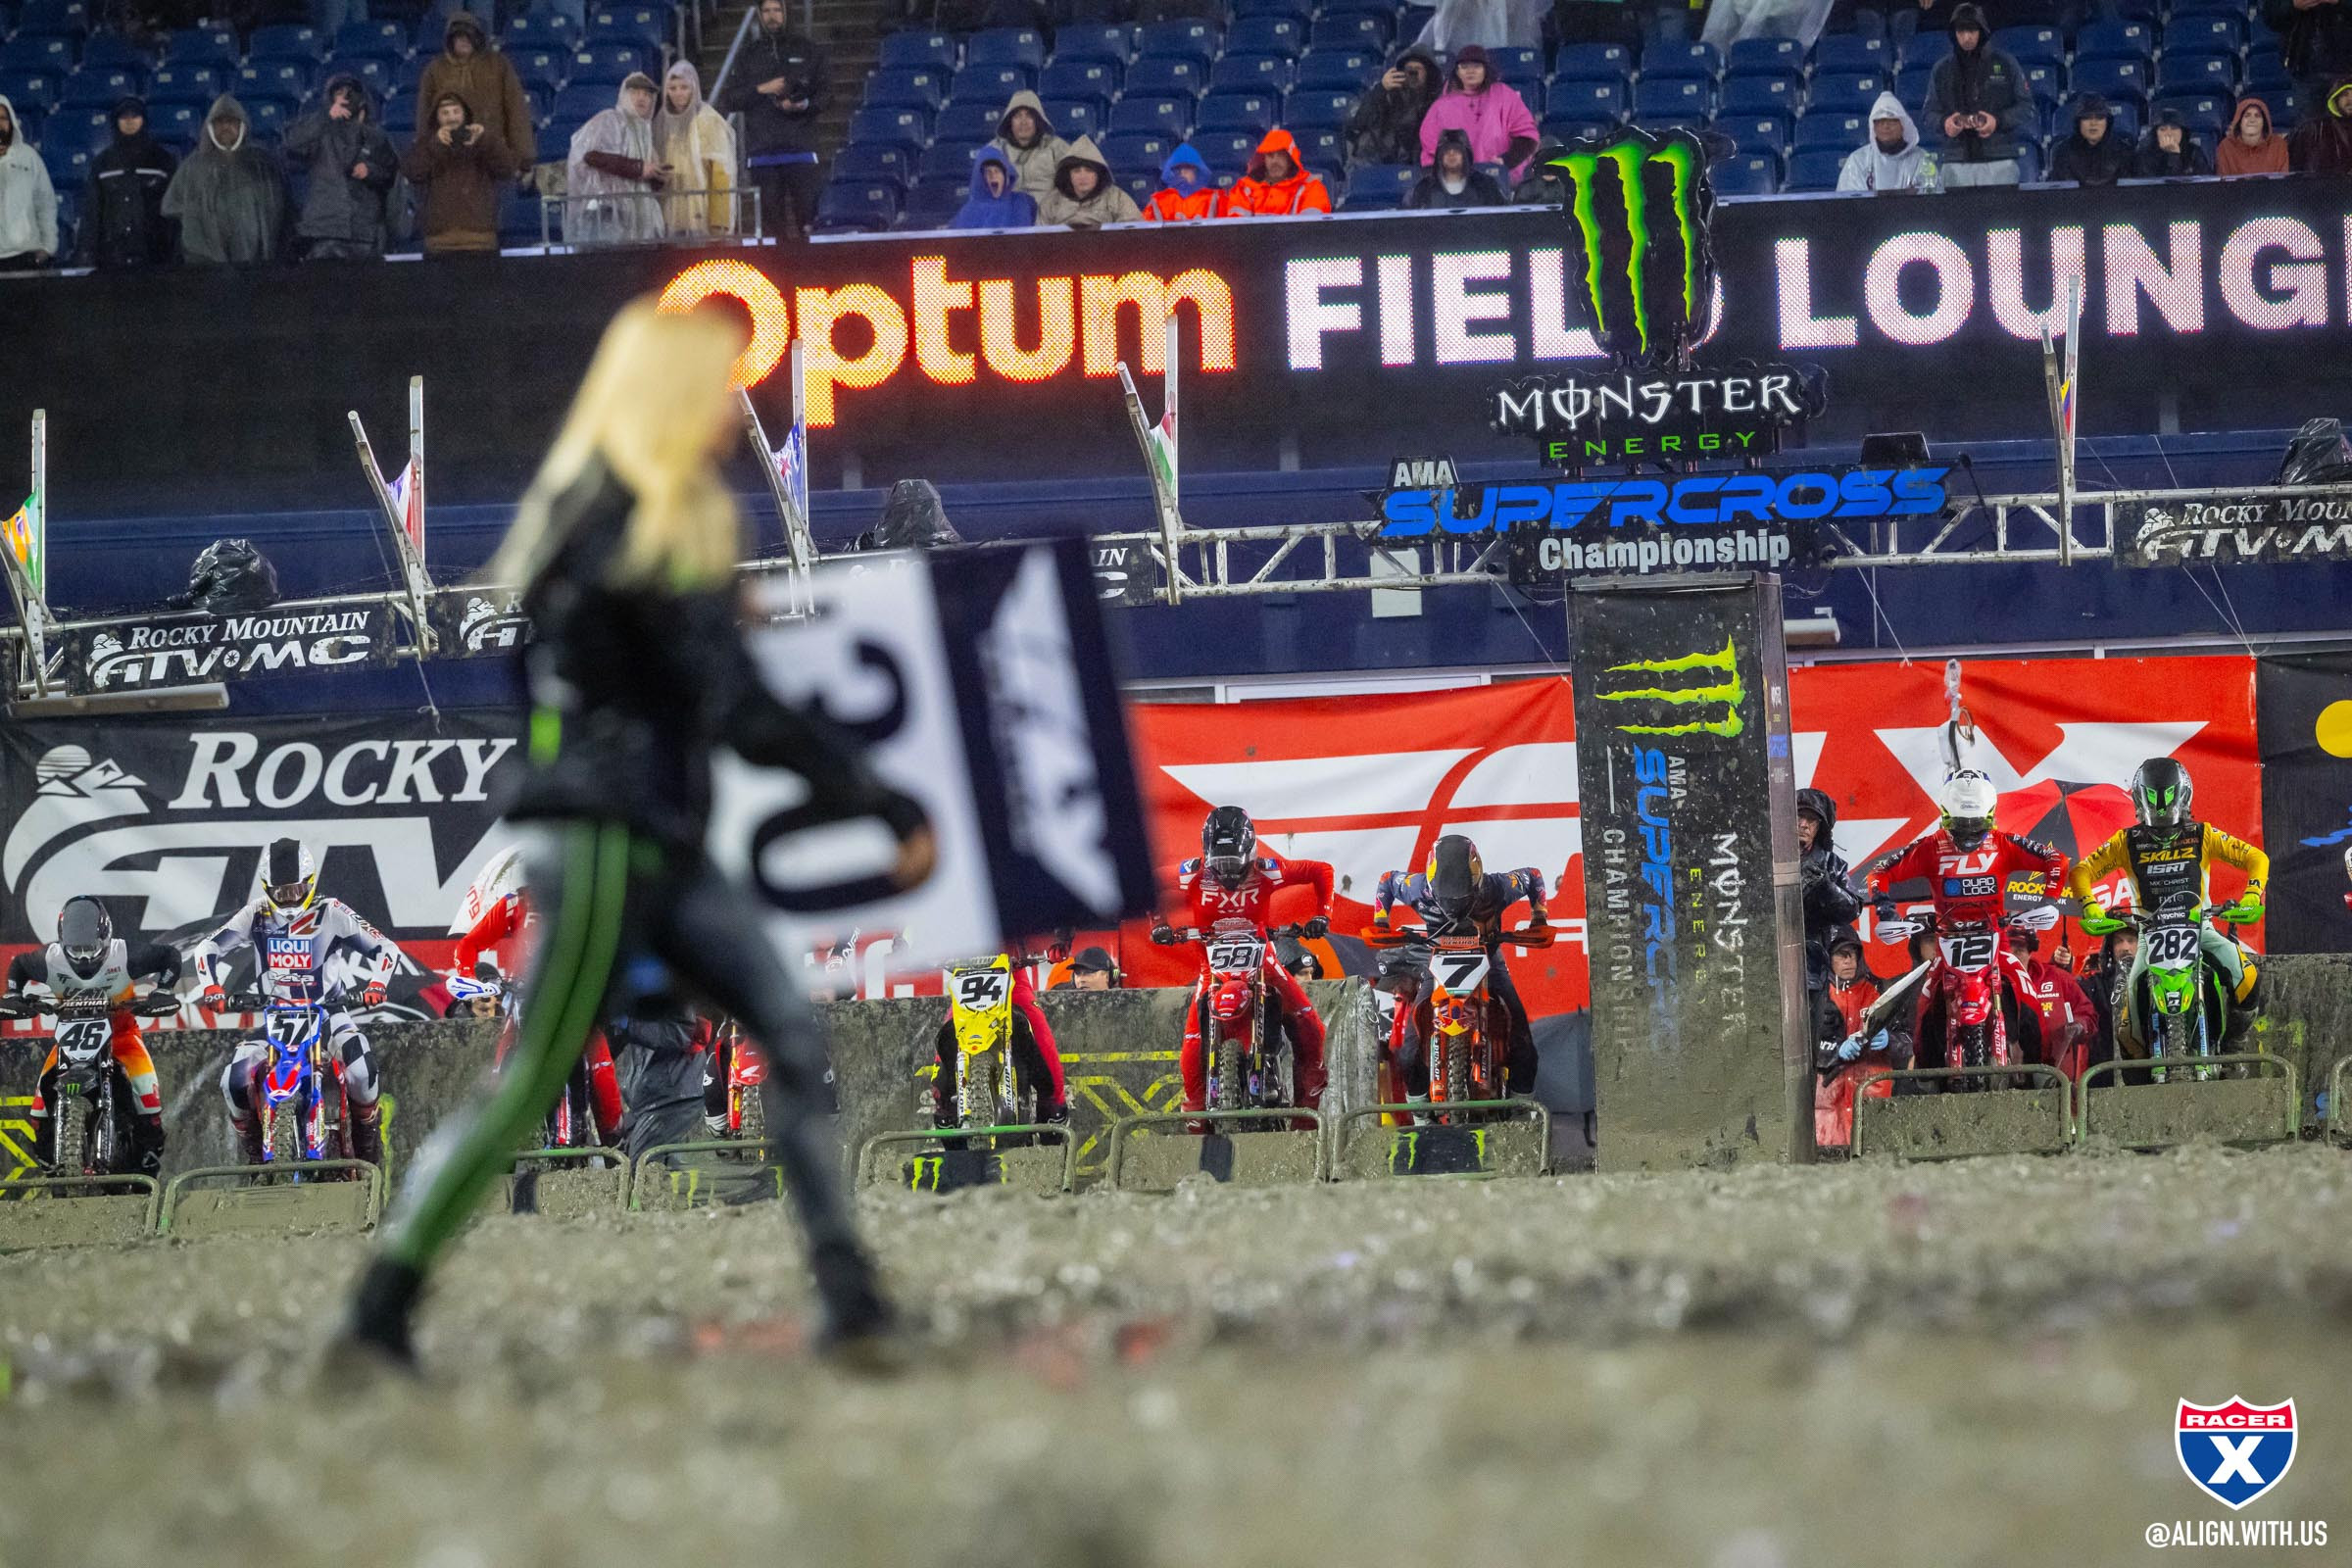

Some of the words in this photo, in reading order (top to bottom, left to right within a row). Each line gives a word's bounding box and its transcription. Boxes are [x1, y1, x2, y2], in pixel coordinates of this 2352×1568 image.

[1285, 247, 1724, 370] FIEL
[1775, 214, 2352, 351] LOUNG
[1497, 374, 1801, 430] MONSTER
[1548, 431, 1758, 459] ENERGY
[1394, 460, 1456, 487] AMA
[1380, 467, 1951, 538] SUPERCROSS
[1539, 529, 1791, 575] Championship
[127, 624, 218, 650] ROCKY
[221, 611, 371, 641] MOUNTAIN
[168, 732, 517, 809] ROCKY
[1667, 755, 1688, 801] AMA
[1938, 852, 1999, 875] FLY
[2138, 847, 2197, 863] SKILLZ
[1963, 877, 1995, 888] QUAD
[1963, 886, 1996, 896] LOCK
[2006, 881, 2074, 899] ROCKAR
[1200, 887, 1260, 908] FXR
[2012, 894, 2043, 903] ENERGY
[270, 939, 311, 954] LIQUI
[1210, 946, 1262, 970] 581
[1949, 935, 1993, 967] 12
[2148, 930, 2198, 965] 282
[270, 954, 312, 968] MOLY
[1441, 956, 1484, 989] 7
[959, 976, 1003, 1004] 94
[59, 1022, 107, 1052] 46
[270, 1013, 318, 1046] 57
